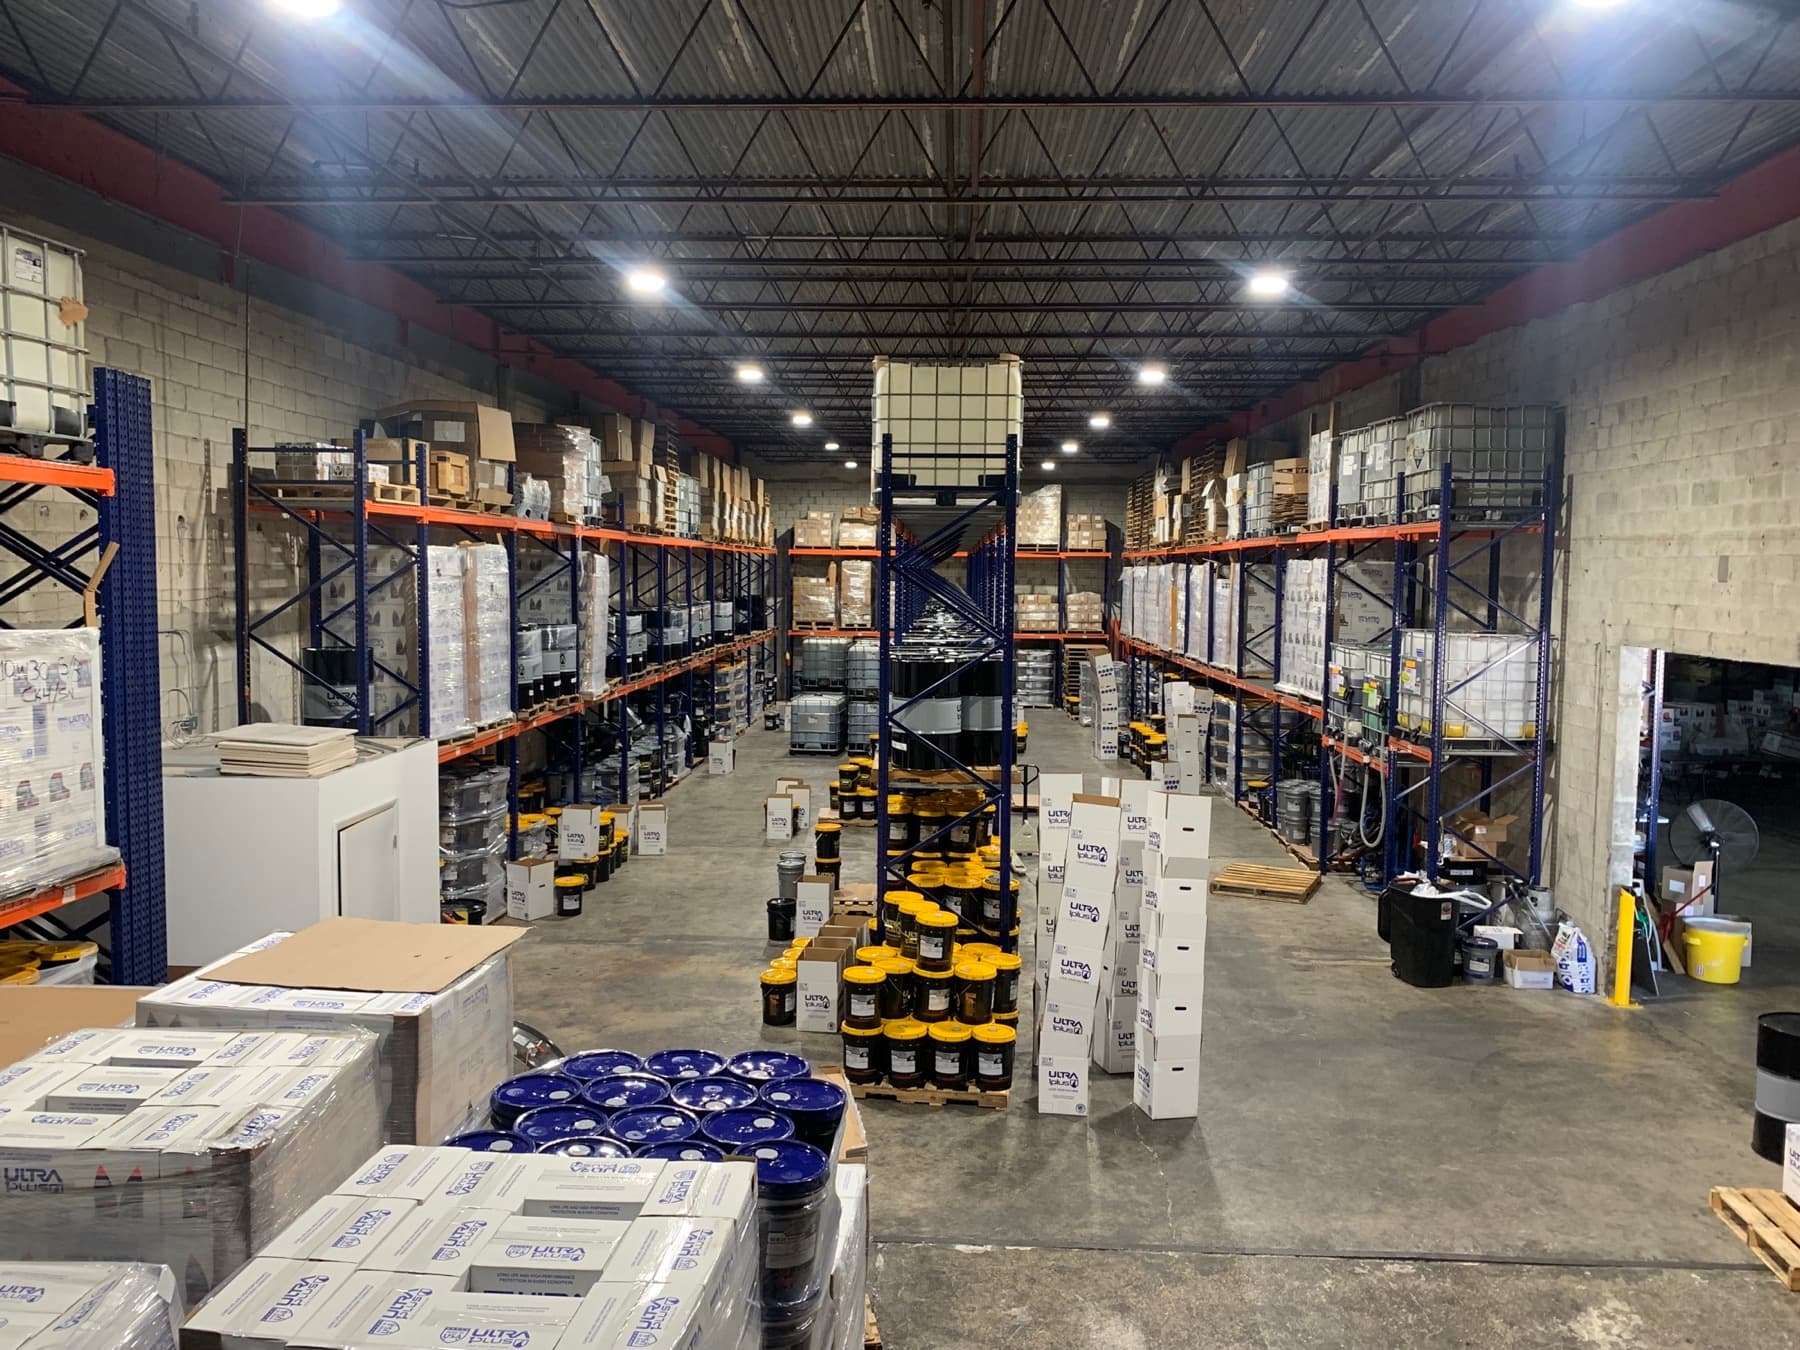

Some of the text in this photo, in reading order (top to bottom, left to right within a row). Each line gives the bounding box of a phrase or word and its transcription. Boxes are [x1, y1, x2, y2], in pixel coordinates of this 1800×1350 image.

[1127, 816, 1147, 824] ULTR
[1077, 843, 1107, 854] ULTRA
[1070, 902, 1099, 913] ULTRA
[1061, 959, 1091, 970] ULTRA
[1053, 1016, 1083, 1028] ULTRA
[1048, 1070, 1078, 1080] ULTRA
[4, 1167, 63, 1183] ULTRA
[533, 1245, 586, 1256] ULTRA
[276, 1275, 317, 1306] ULTRA
[383, 1287, 420, 1319] ULTRA
[636, 1297, 666, 1330] ULTRA
[471, 1328, 531, 1340] ULTRA
